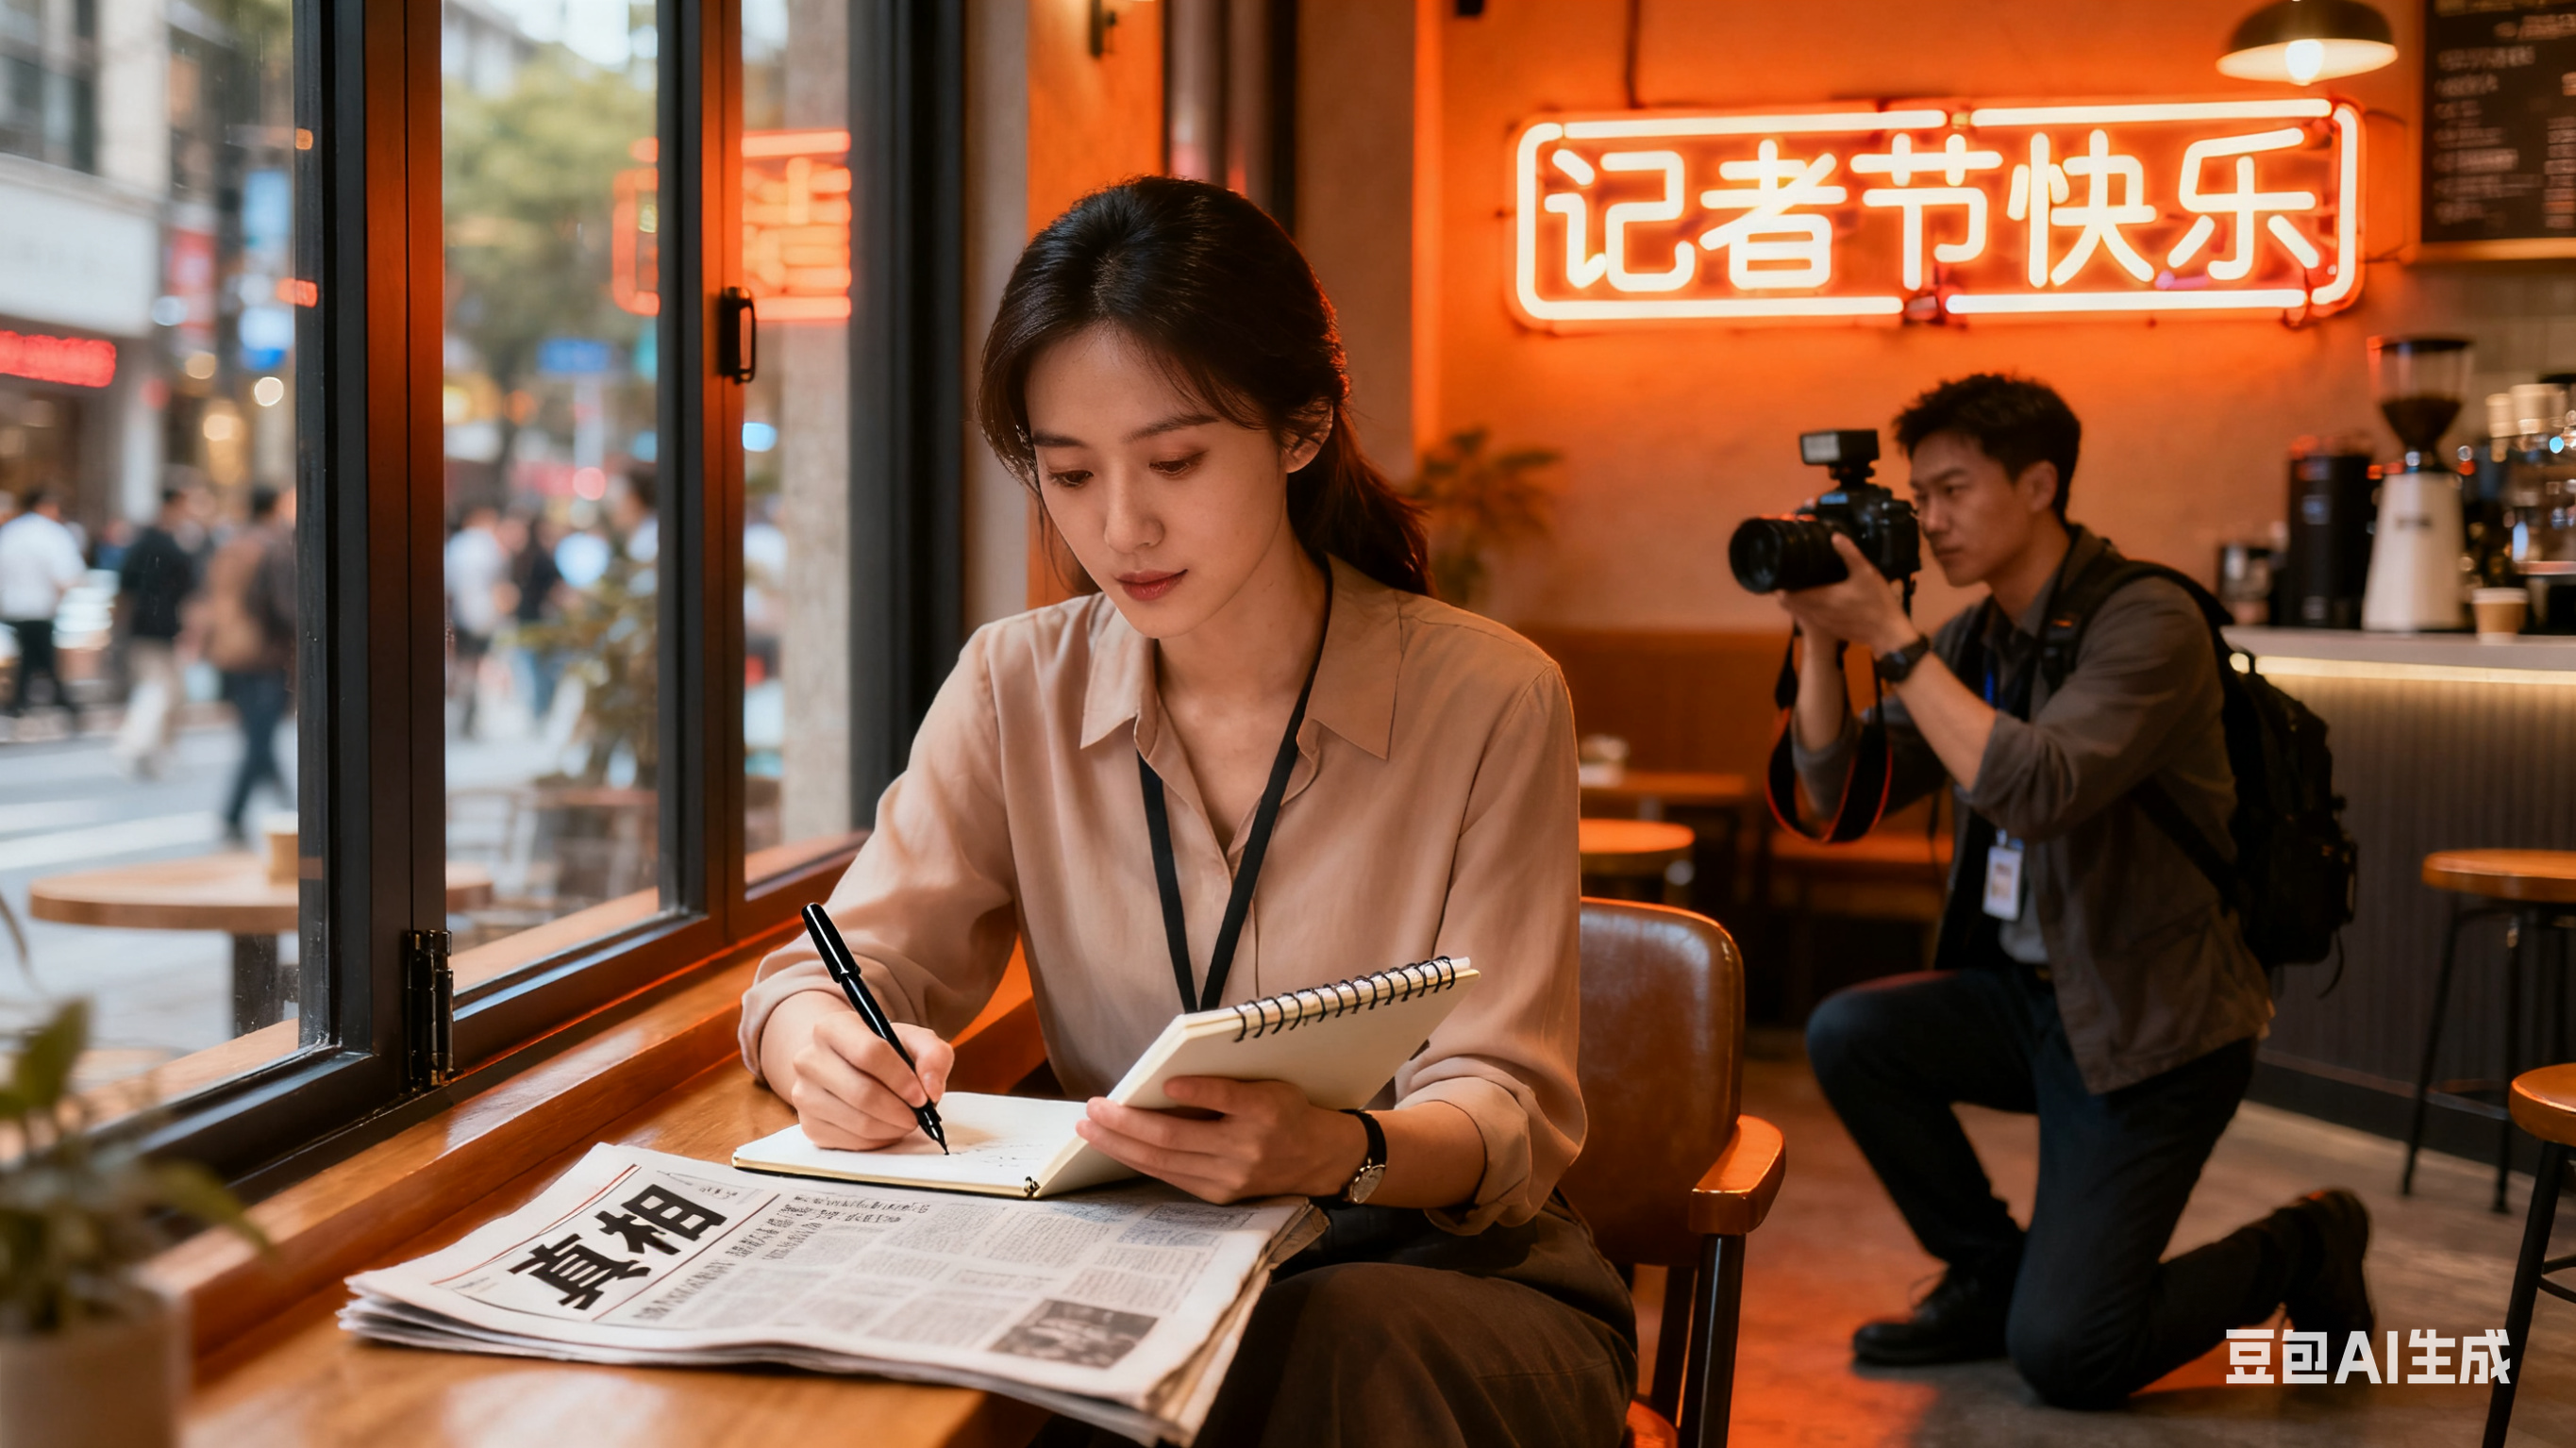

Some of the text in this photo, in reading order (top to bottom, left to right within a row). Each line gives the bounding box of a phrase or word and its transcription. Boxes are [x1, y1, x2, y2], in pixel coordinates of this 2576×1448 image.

[1544, 128, 2320, 292] 记者节快乐
[507, 1184, 728, 1310] 真相
